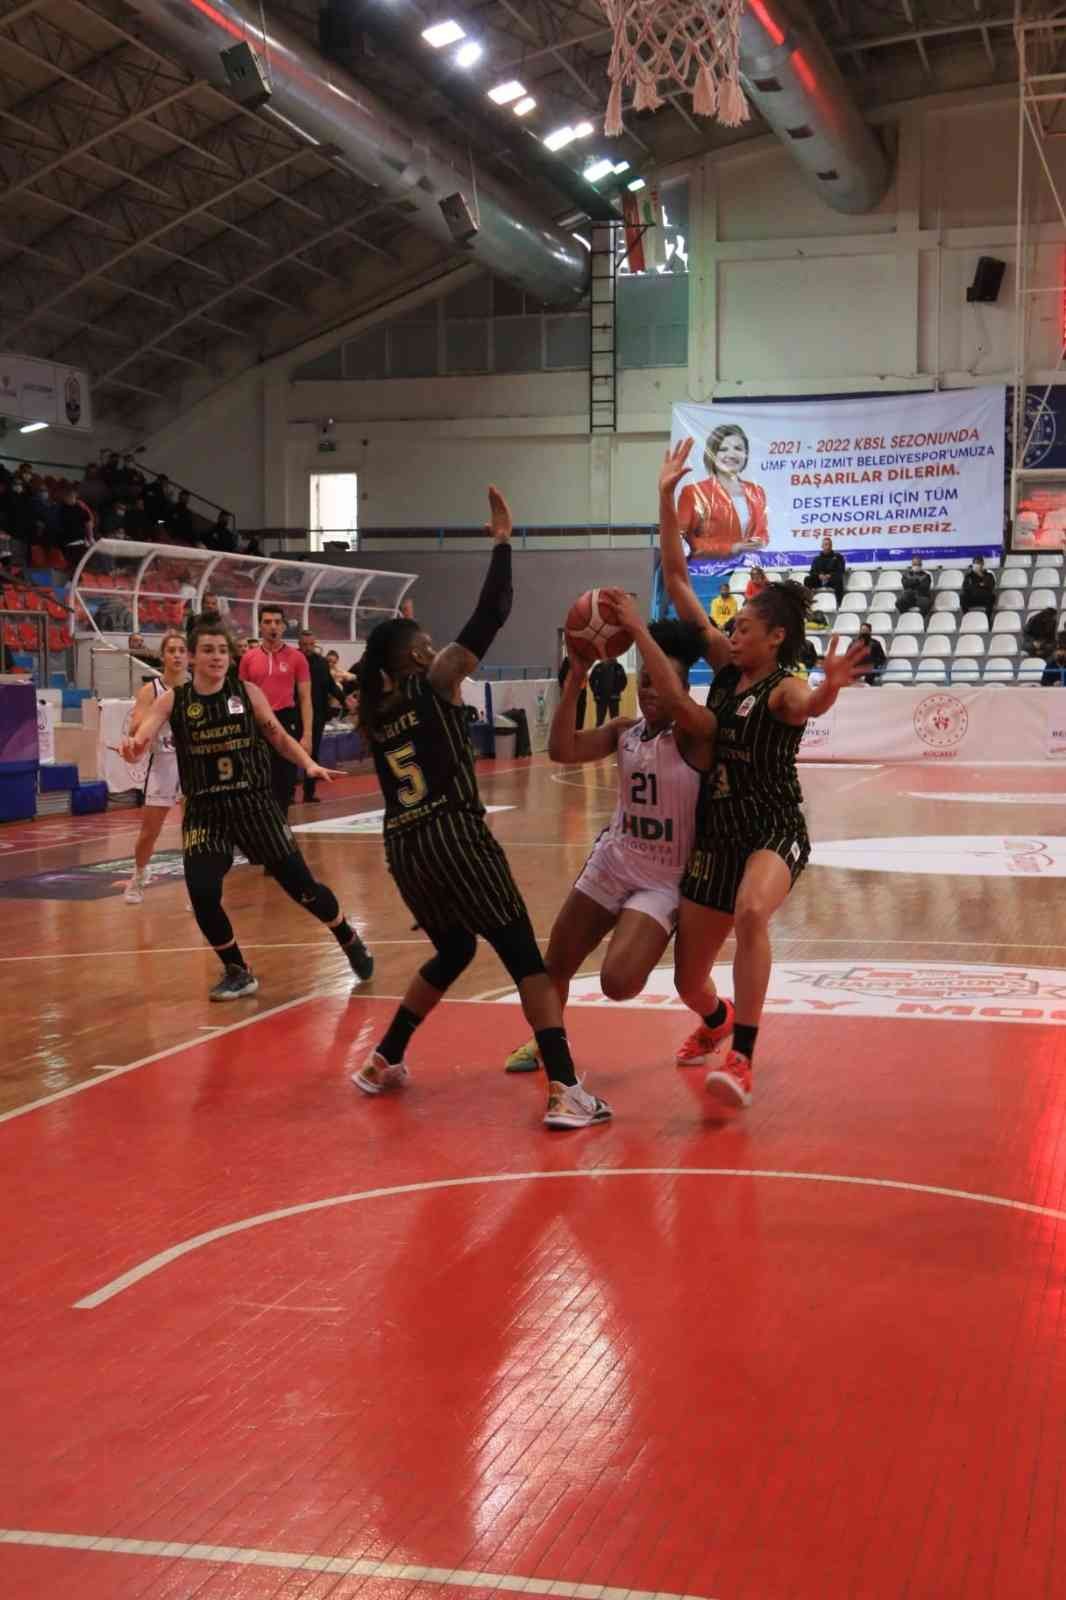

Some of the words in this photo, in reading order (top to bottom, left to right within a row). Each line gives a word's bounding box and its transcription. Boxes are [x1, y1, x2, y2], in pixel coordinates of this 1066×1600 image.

[768, 440, 801, 455] 2021
[815, 438, 850, 453] 2022
[853, 435, 886, 451] KBSL
[891, 427, 980, 448] SEZONUNDA
[760, 460, 787, 471] UMF
[790, 458, 817, 470] YAPI
[791, 470, 882, 488] BAŞARILAR
[887, 463, 960, 481] DİLERİM.
[793, 493, 884, 510] DESTEKLERİ
[889, 490, 920, 507] İÇİN
[924, 487, 959, 501] TÜM
[801, 506, 949, 525] SPONSORLARIMIZA
[887, 521, 957, 535] EDERİZ.
[217, 757, 233, 780] 9
[384, 742, 427, 808] 5
[631, 771, 657, 806] 21
[621, 812, 673, 842] HDI
